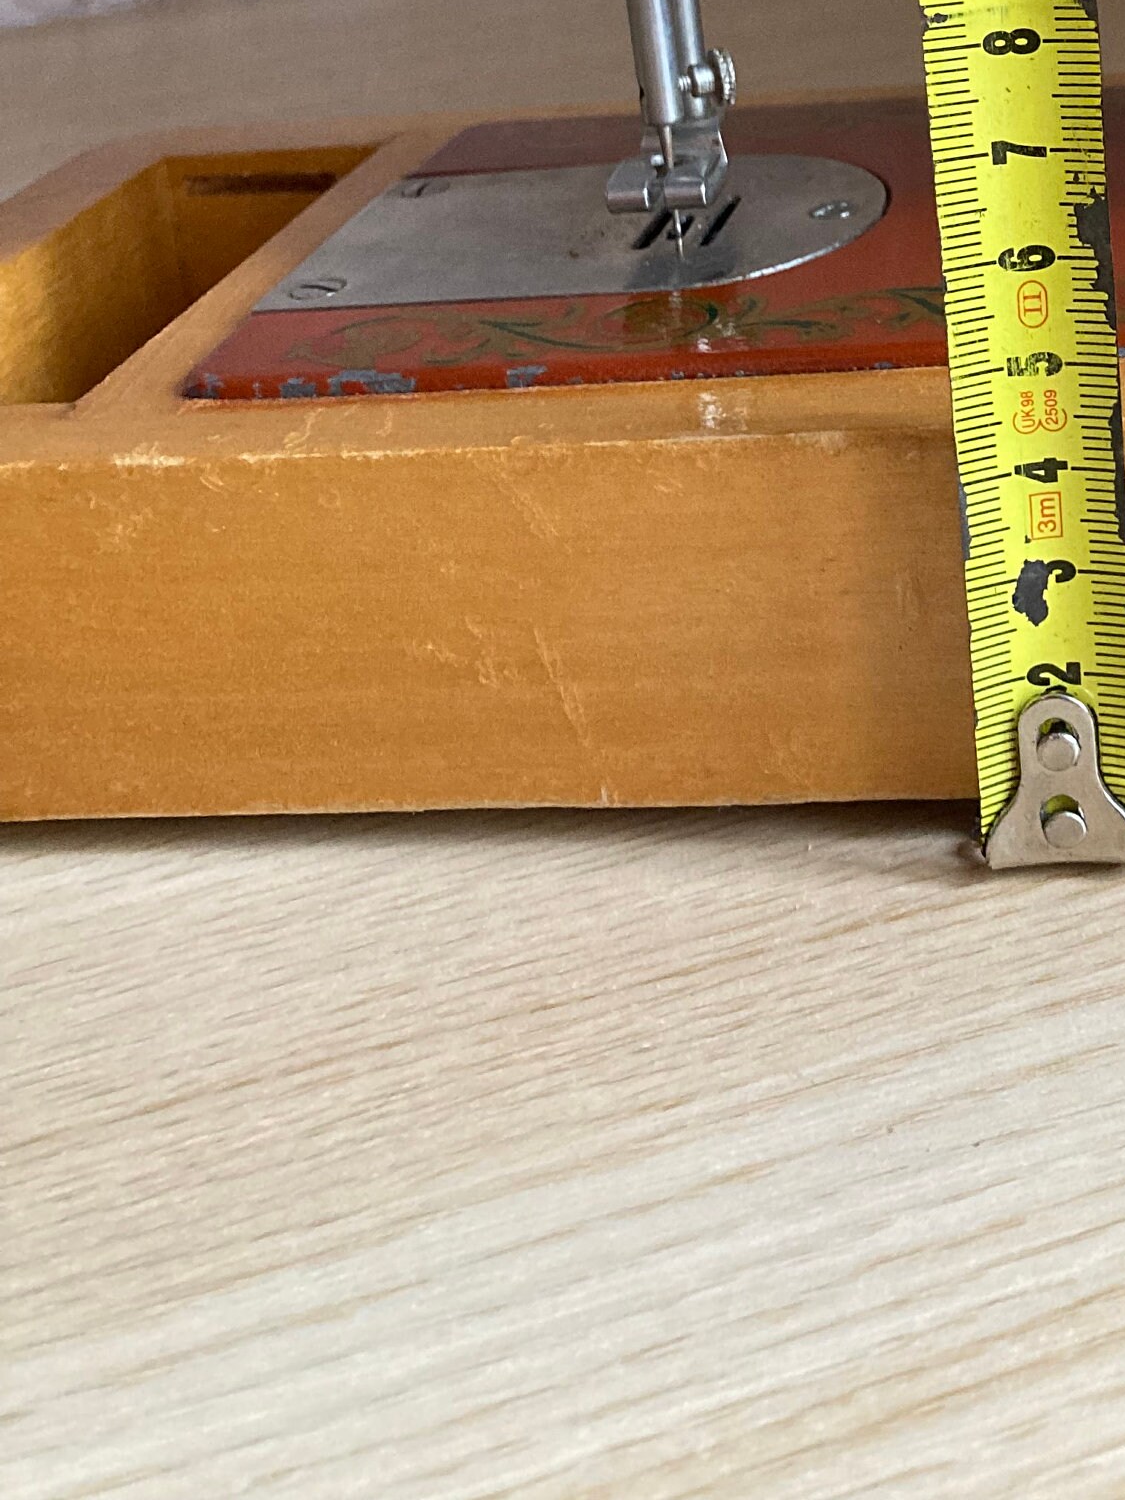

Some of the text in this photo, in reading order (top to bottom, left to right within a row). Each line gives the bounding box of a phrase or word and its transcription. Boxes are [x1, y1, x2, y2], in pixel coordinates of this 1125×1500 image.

[982, 28, 1042, 56] 8
[991, 140, 1047, 165] 7
[998, 244, 1056, 272] 6
[1006, 351, 1063, 377] 5
[1043, 389, 1059, 426] 2509
[1014, 457, 1068, 484] 4
[1037, 498, 1058, 534] 3m
[1027, 662, 1081, 688] 2
